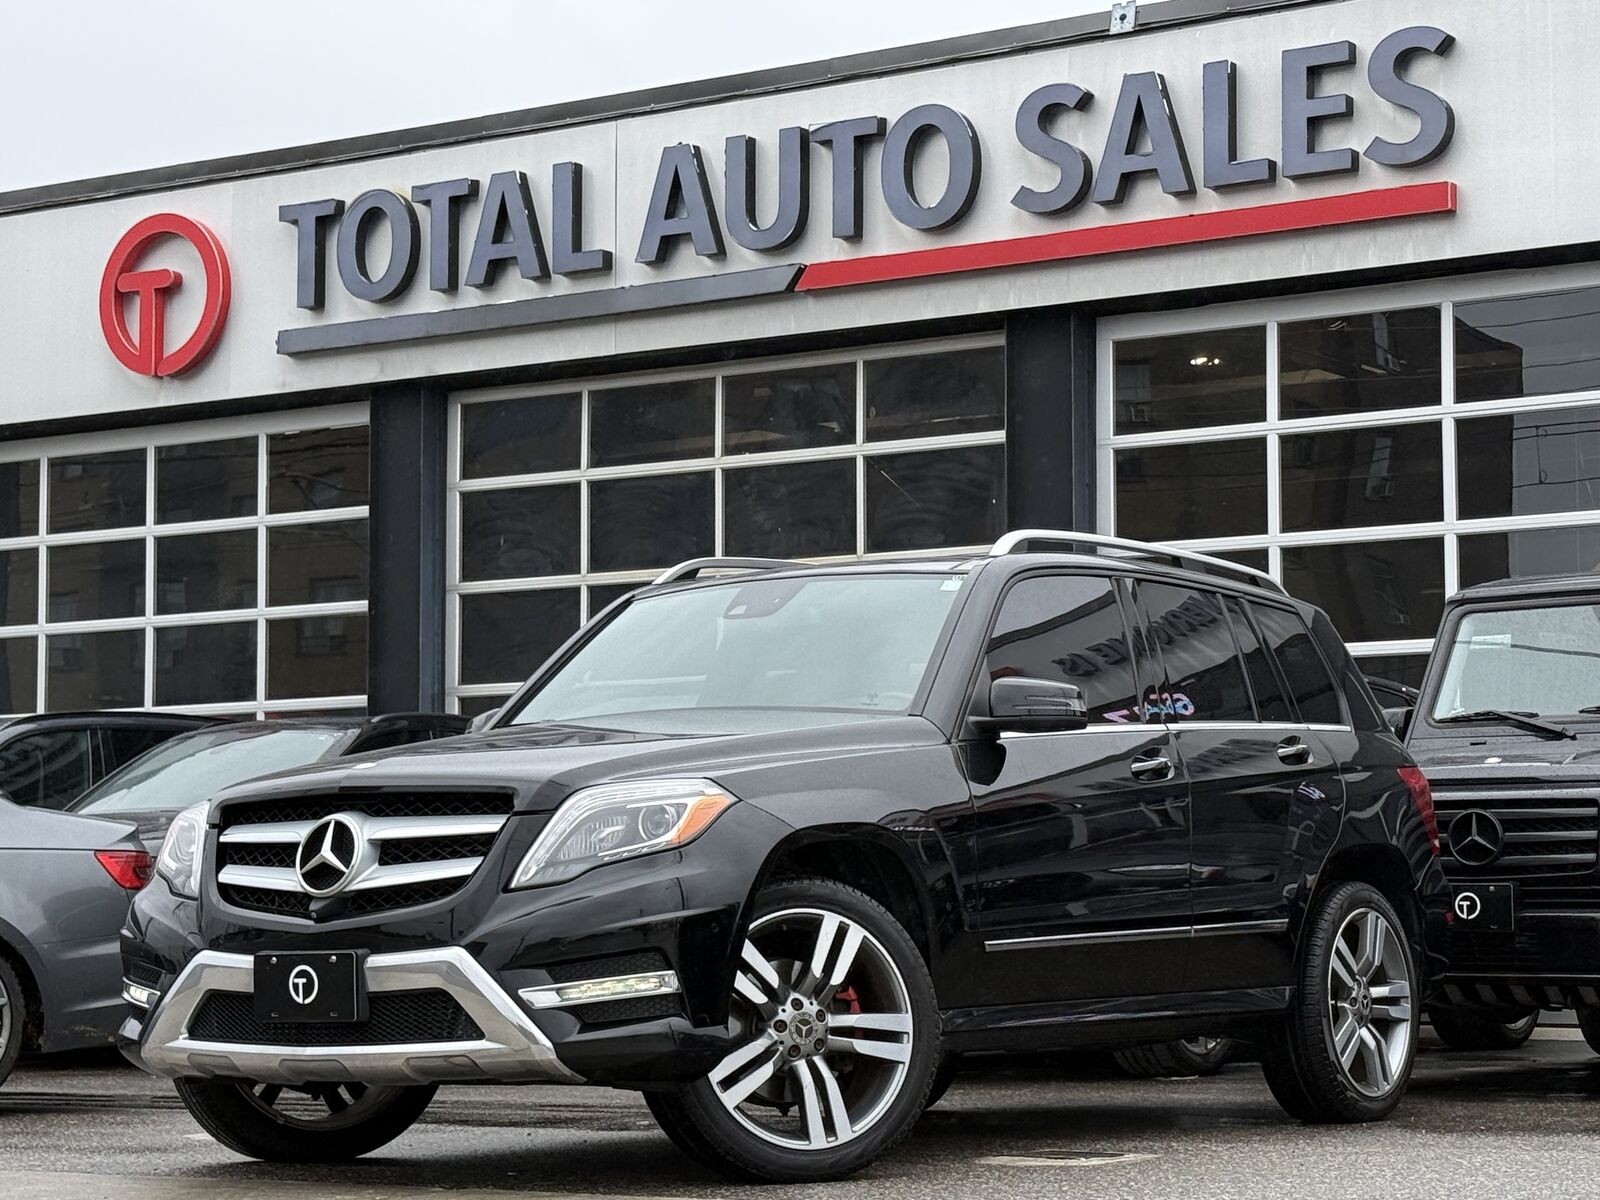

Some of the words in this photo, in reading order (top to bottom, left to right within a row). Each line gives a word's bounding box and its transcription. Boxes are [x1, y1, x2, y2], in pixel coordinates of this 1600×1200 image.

[279, 161, 613, 311] TOTAL
[635, 103, 981, 266] AUTO
[1010, 25, 1456, 215] SALES
